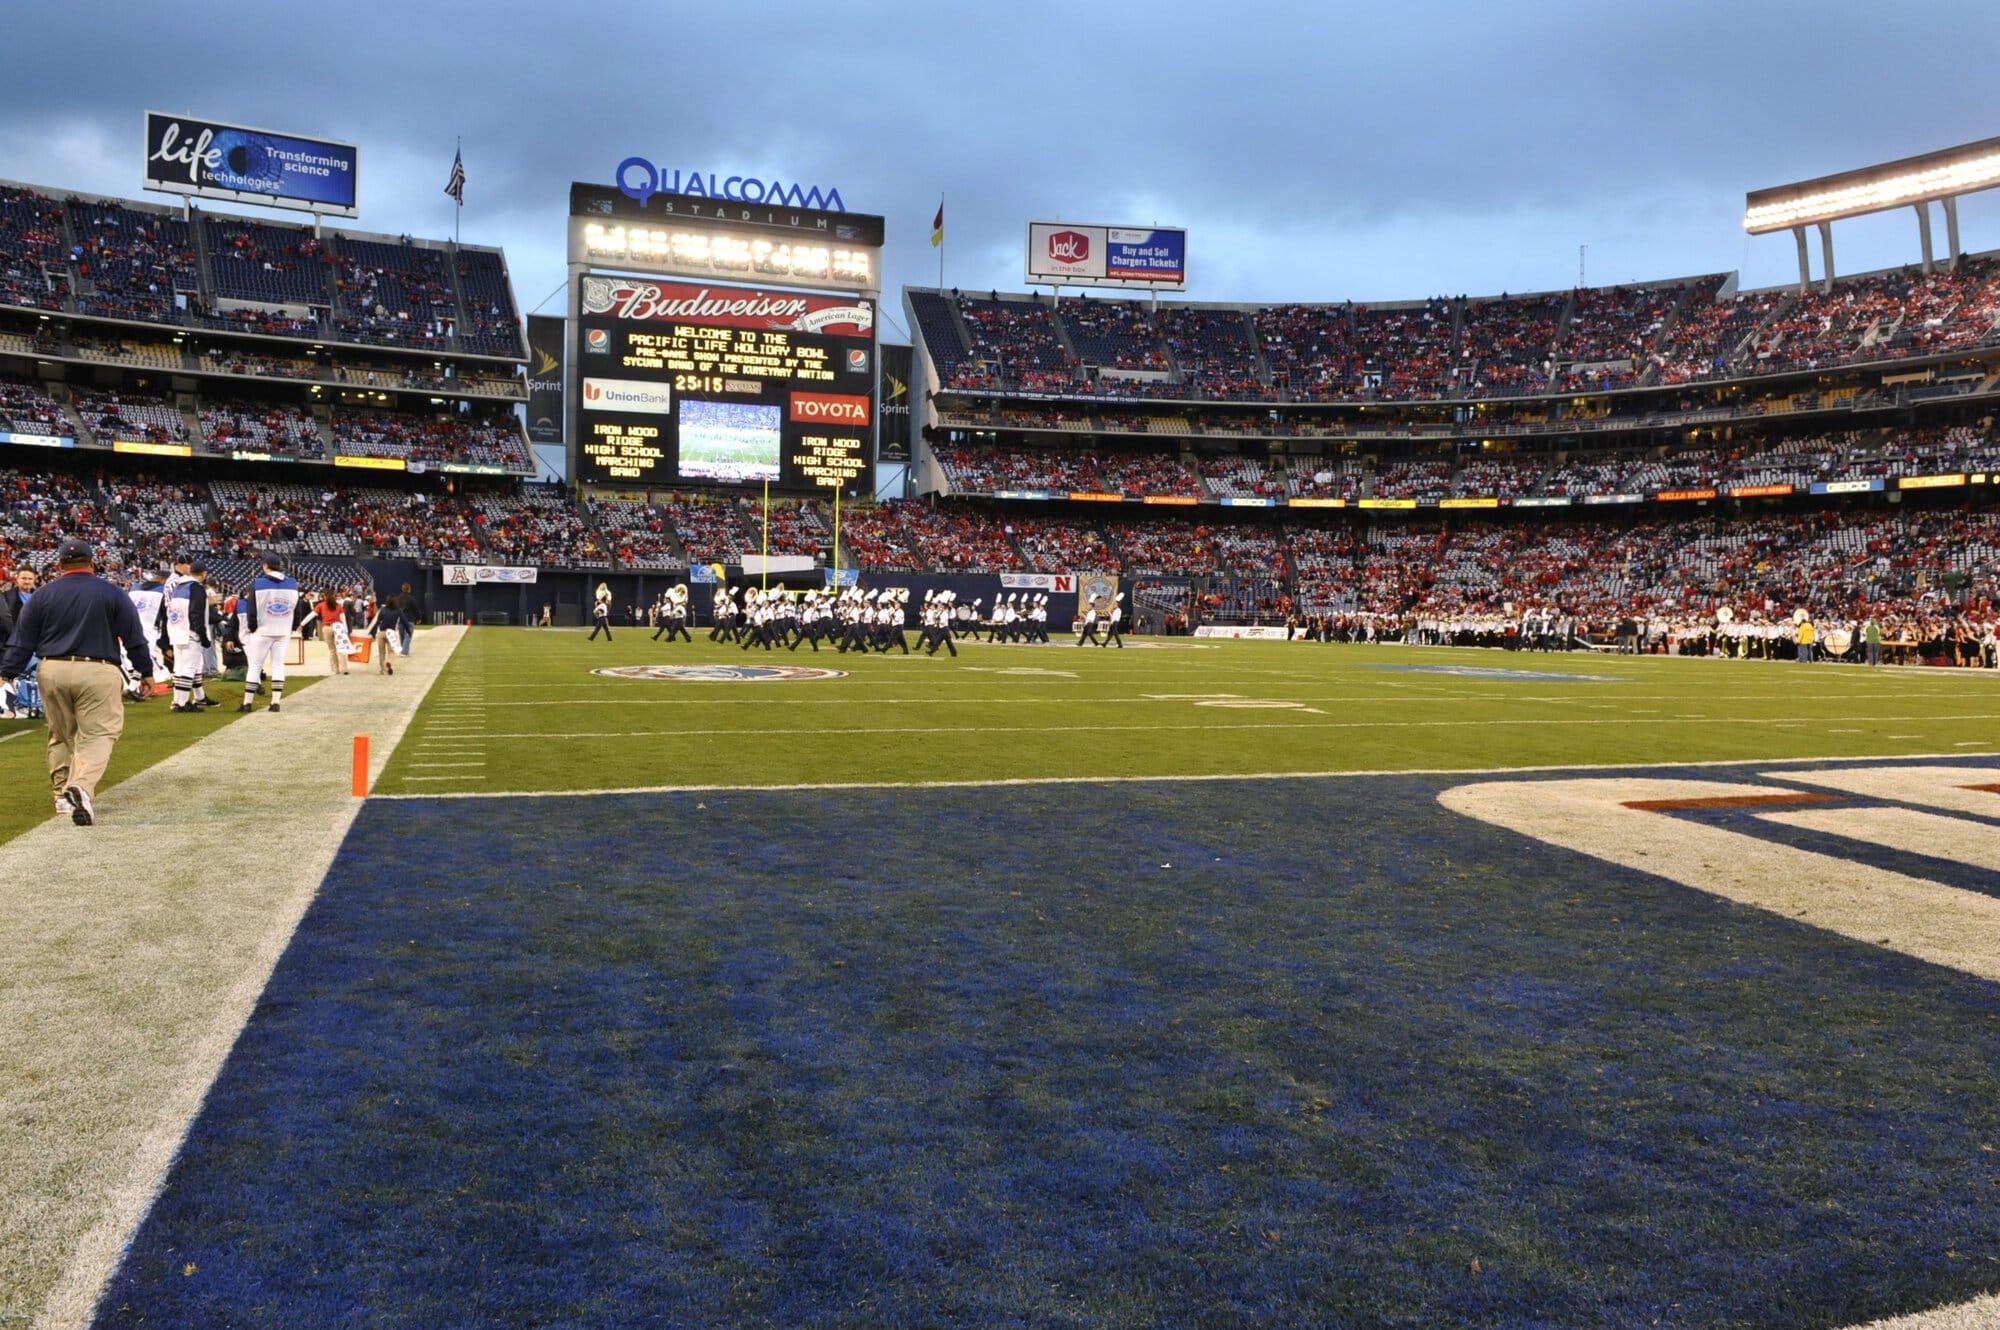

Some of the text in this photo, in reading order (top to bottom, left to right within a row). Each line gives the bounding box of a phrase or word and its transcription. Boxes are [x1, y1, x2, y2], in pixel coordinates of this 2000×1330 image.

[150, 123, 222, 182] life
[265, 147, 349, 171] Transforming
[284, 161, 330, 177] science
[616, 157, 846, 213] QUALCOMM
[666, 202, 827, 229] STADIUM
[1051, 235, 1088, 260] Jack
[1122, 246, 1169, 257] Buy and Sell
[1112, 256, 1179, 268] Chargers Tickets!
[609, 286, 807, 320] Budweiser
[808, 311, 870, 328] American Lager
[674, 326, 787, 345] WELCOME TO THE
[629, 334, 829, 359] PACIFIC LIFE HOLIDAY BOWL
[636, 347, 823, 369] PRE-GAME SHOW PRESENTED BY THE
[623, 356, 663, 368] SYCUAN
[668, 360, 694, 370] BAND
[699, 362, 713, 371] OF
[718, 363, 738, 374] THE
[797, 369, 834, 380] NATION
[528, 379, 562, 392] Sprint
[675, 375, 723, 393] 25:15
[606, 391, 668, 404] UnionBank
[794, 400, 866, 419] TOYOTA
[880, 403, 909, 416] Sprint
[594, 424, 658, 437] IRON WOOD
[606, 435, 644, 446] RIDGE
[802, 436, 860, 448] IRON WOOD
[585, 444, 664, 457] HIGH SCHOOL
[813, 447, 847, 457] RIDGE
[596, 456, 654, 468] MARCHING
[793, 455, 866, 468] HIGH SCHOOL
[610, 467, 640, 477] BAND
[803, 466, 857, 477] MARCHING
[816, 477, 844, 487] BAND
[1658, 490, 1716, 500] WELLS FARGO
[451, 566, 469, 584] A
[1055, 577, 1070, 591] N
